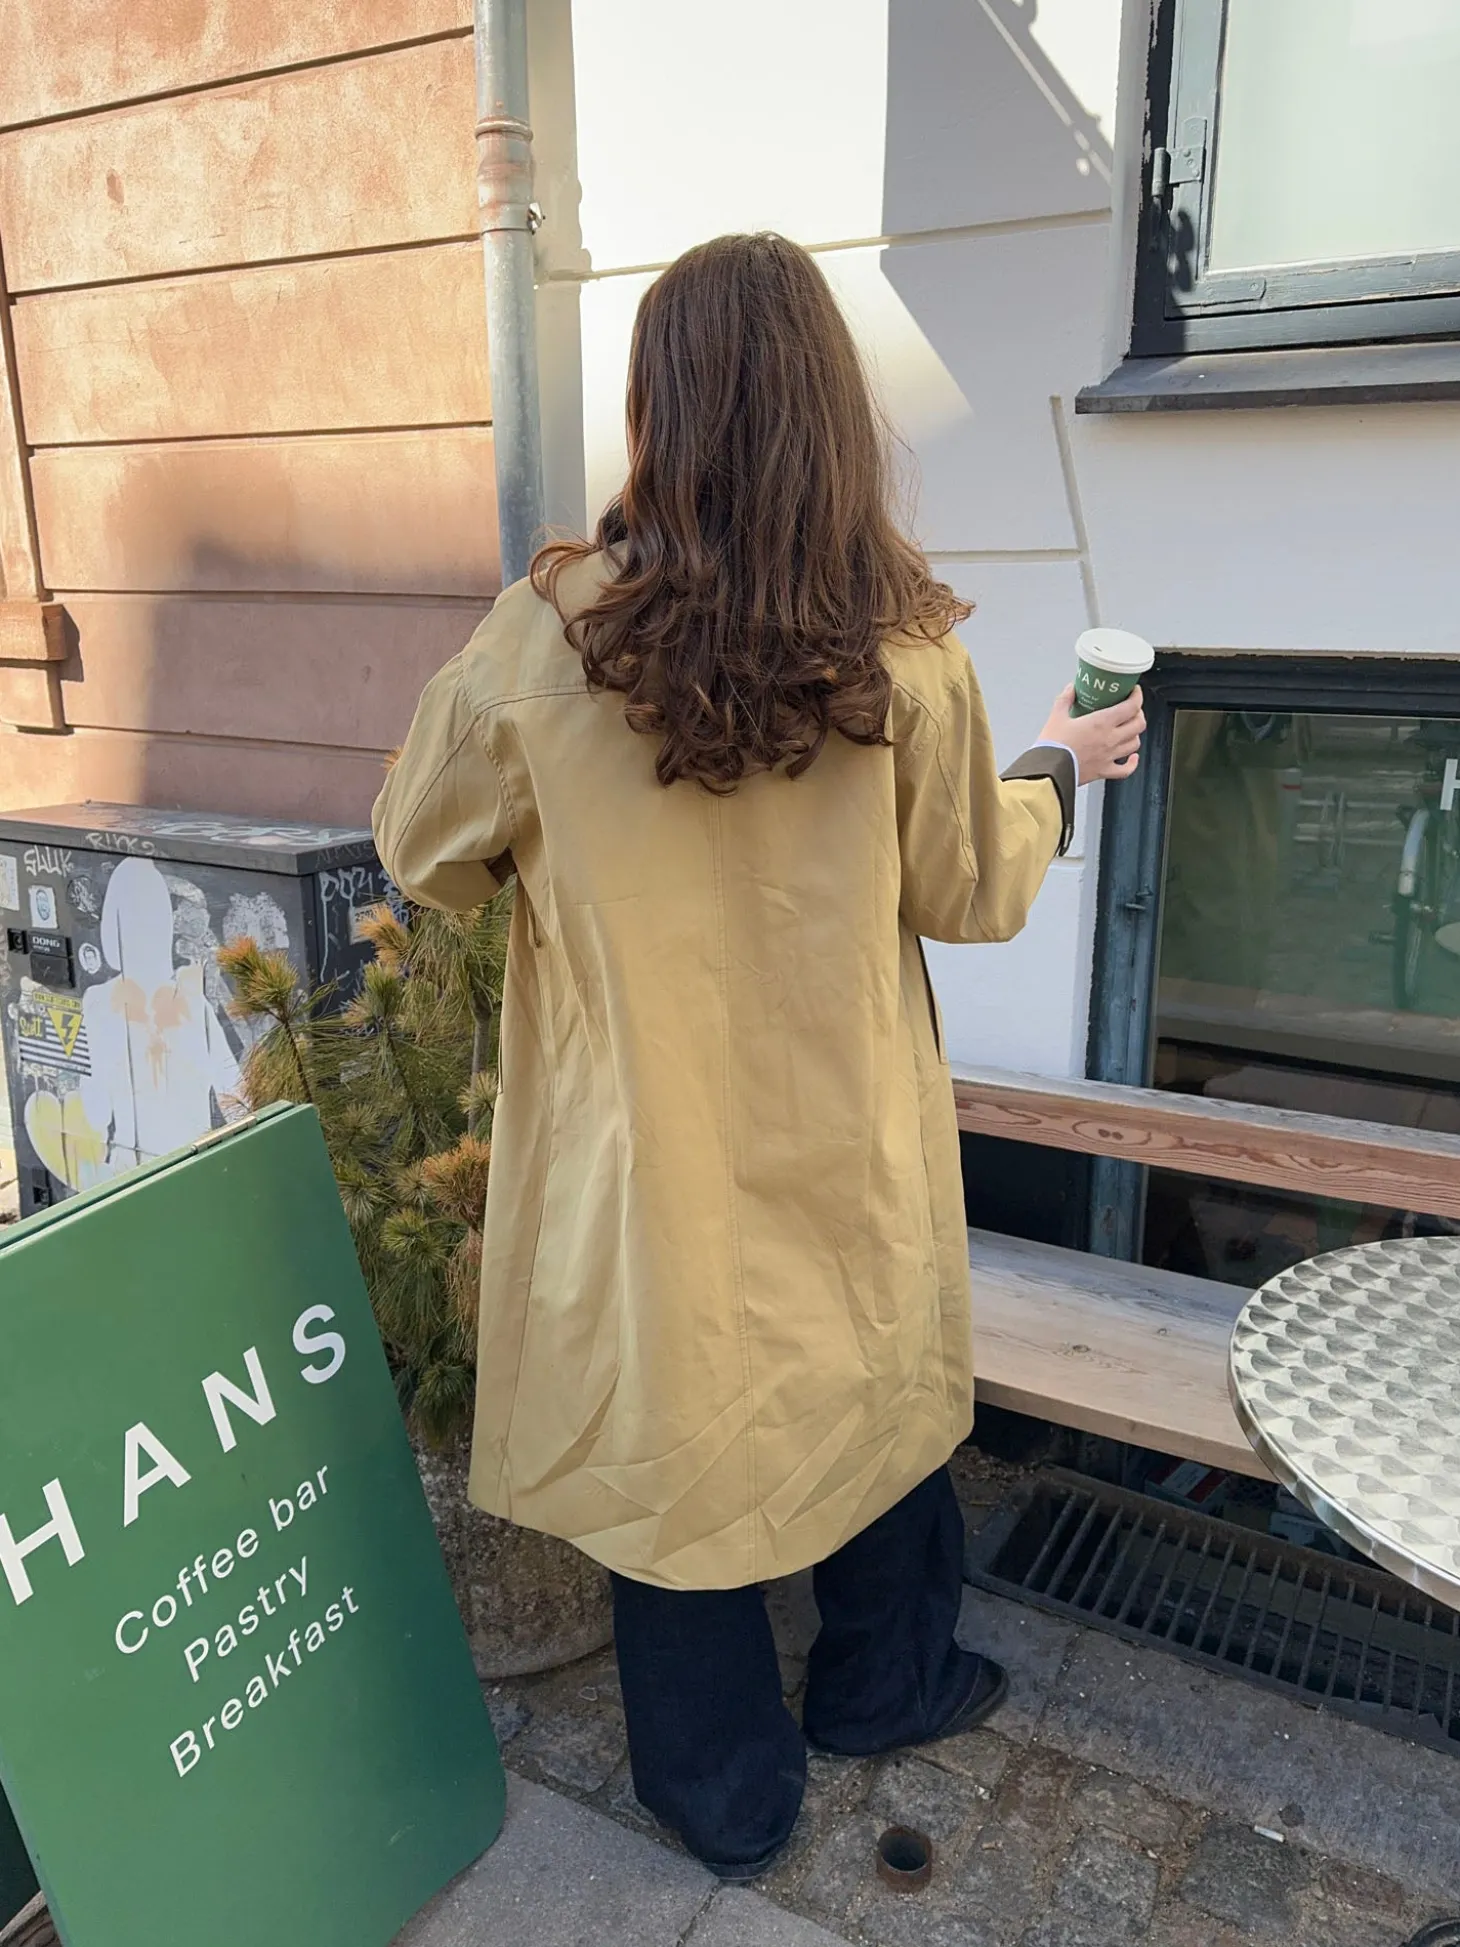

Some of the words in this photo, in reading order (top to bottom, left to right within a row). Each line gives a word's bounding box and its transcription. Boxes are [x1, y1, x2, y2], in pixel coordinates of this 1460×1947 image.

[32, 935, 61, 948] DONG
[0, 1303, 347, 1607] HANS
[114, 1527, 260, 1655] Coffee
[267, 1464, 329, 1532] bar
[182, 1555, 309, 1683] Pastry
[168, 1585, 360, 1779] Breakfast
